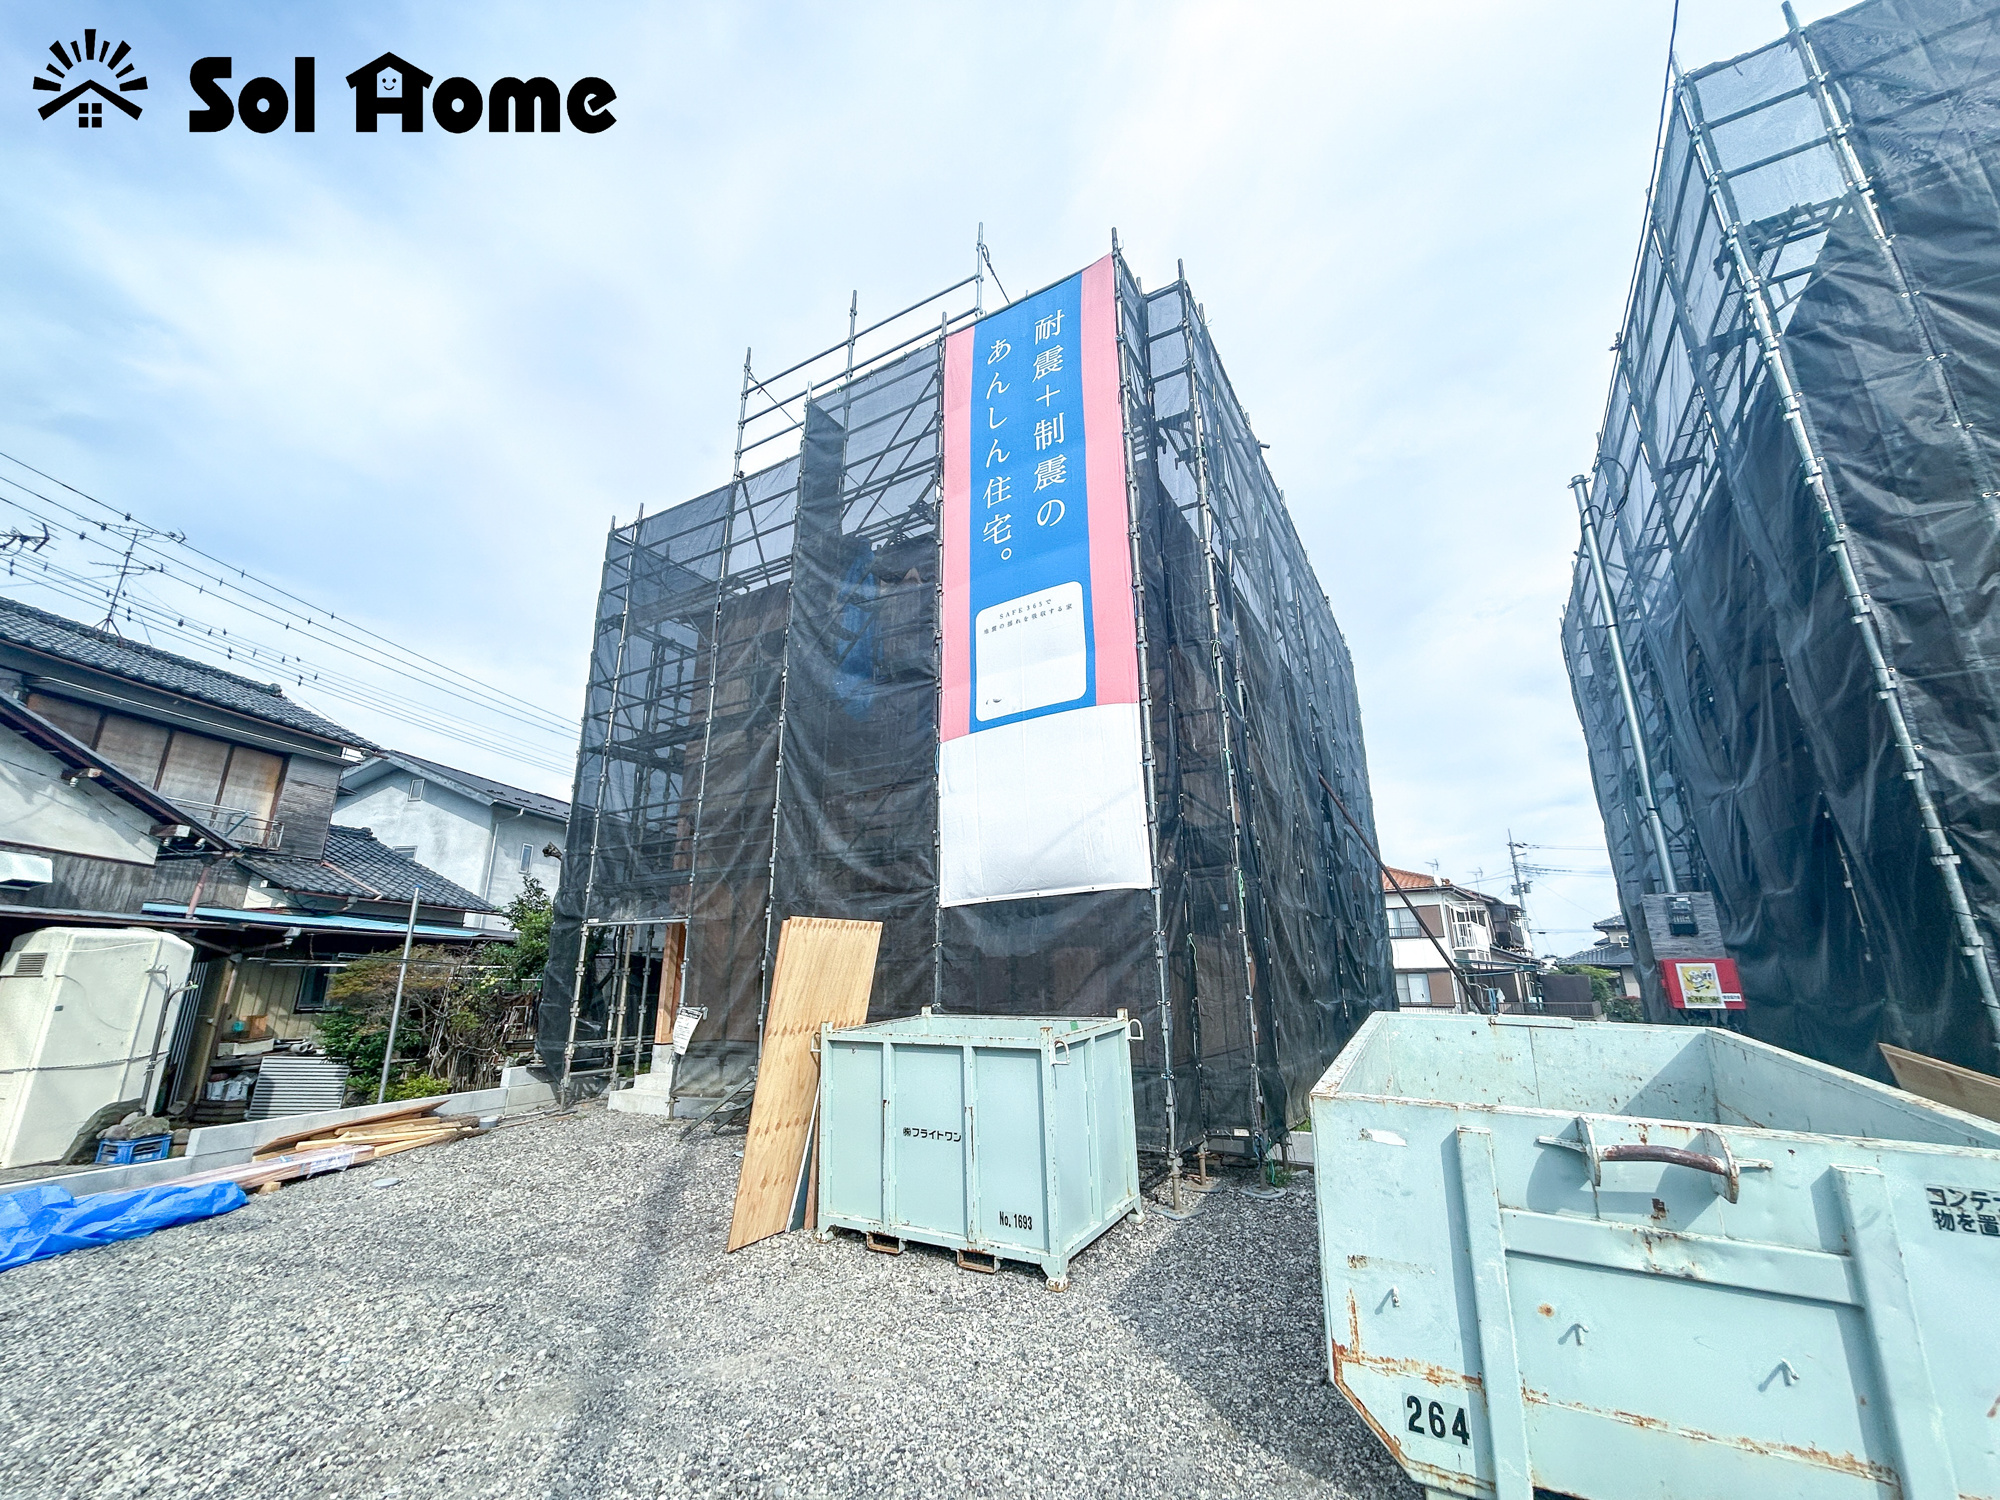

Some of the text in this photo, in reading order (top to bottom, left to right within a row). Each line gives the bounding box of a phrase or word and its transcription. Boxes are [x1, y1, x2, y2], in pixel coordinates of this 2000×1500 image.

[982, 338, 1013, 561] あんしん住宅。
[1926, 1187, 2000, 1211] コンテ
[1406, 1395, 1470, 1446] 264
